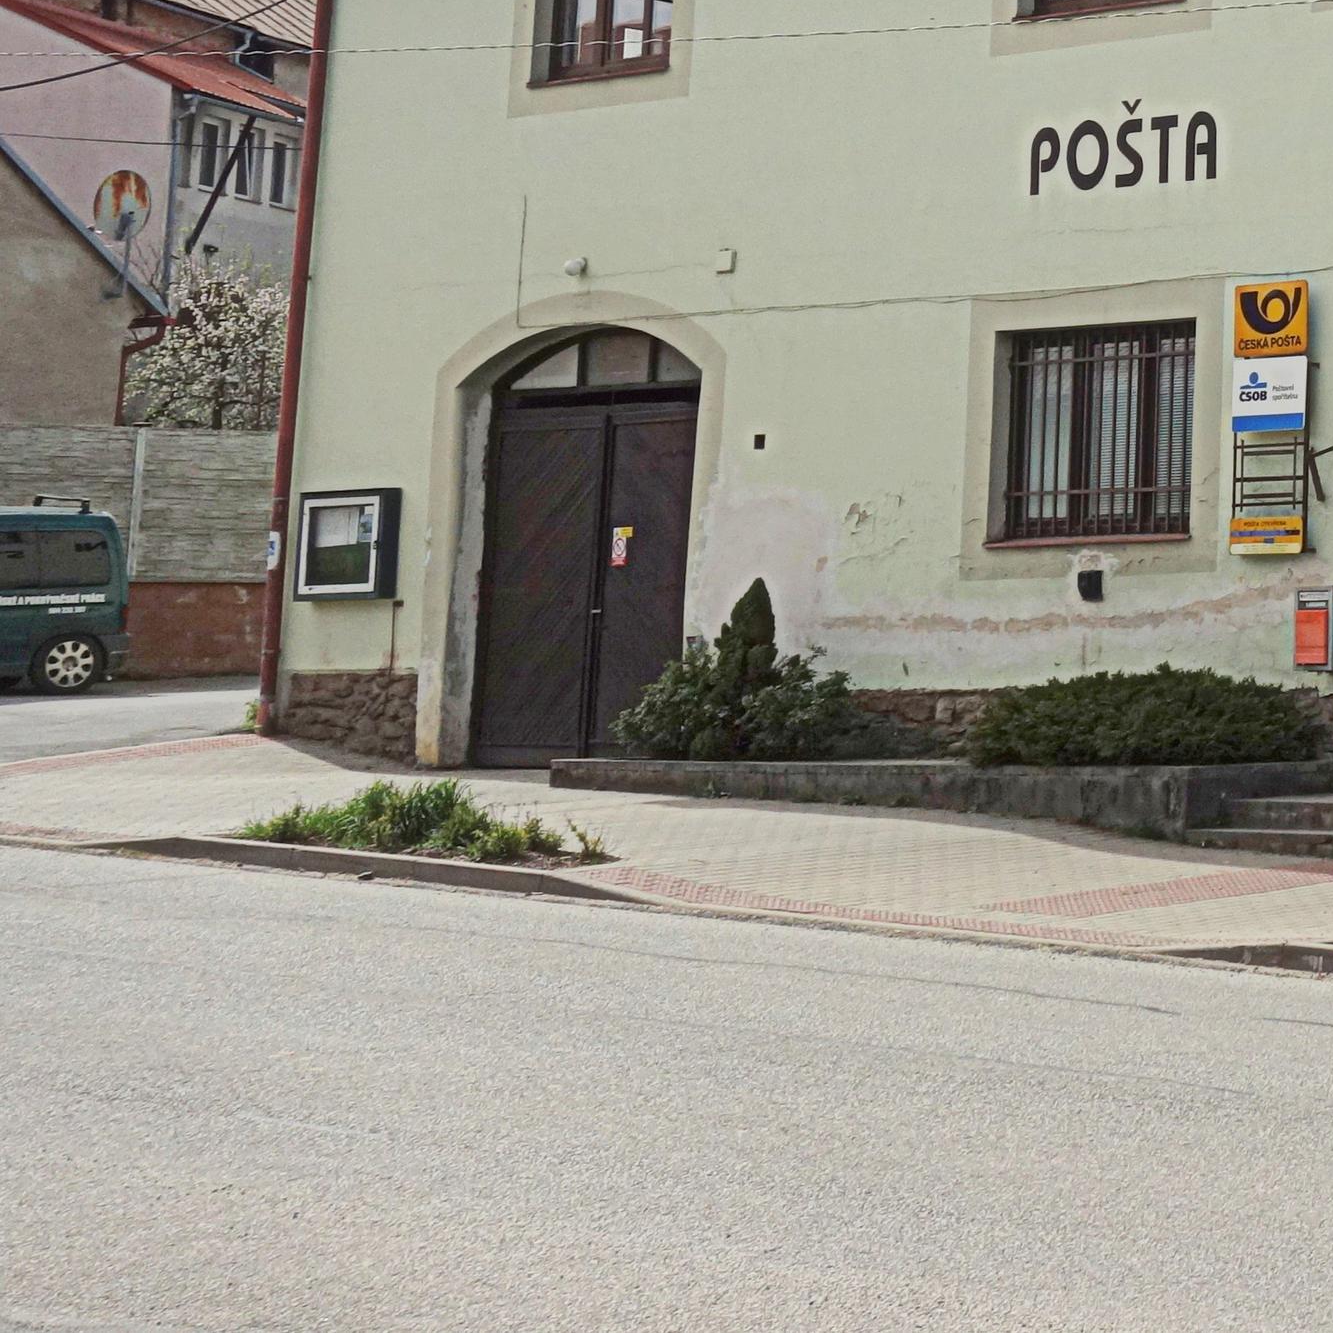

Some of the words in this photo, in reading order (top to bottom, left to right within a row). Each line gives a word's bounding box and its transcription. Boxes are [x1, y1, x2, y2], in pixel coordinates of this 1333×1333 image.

[1029, 98, 1217, 196] POŠTA
[1238, 336, 1269, 351] ČESKÁ
[1271, 334, 1302, 348] POŠTA
[1239, 389, 1268, 402] ČSOB
